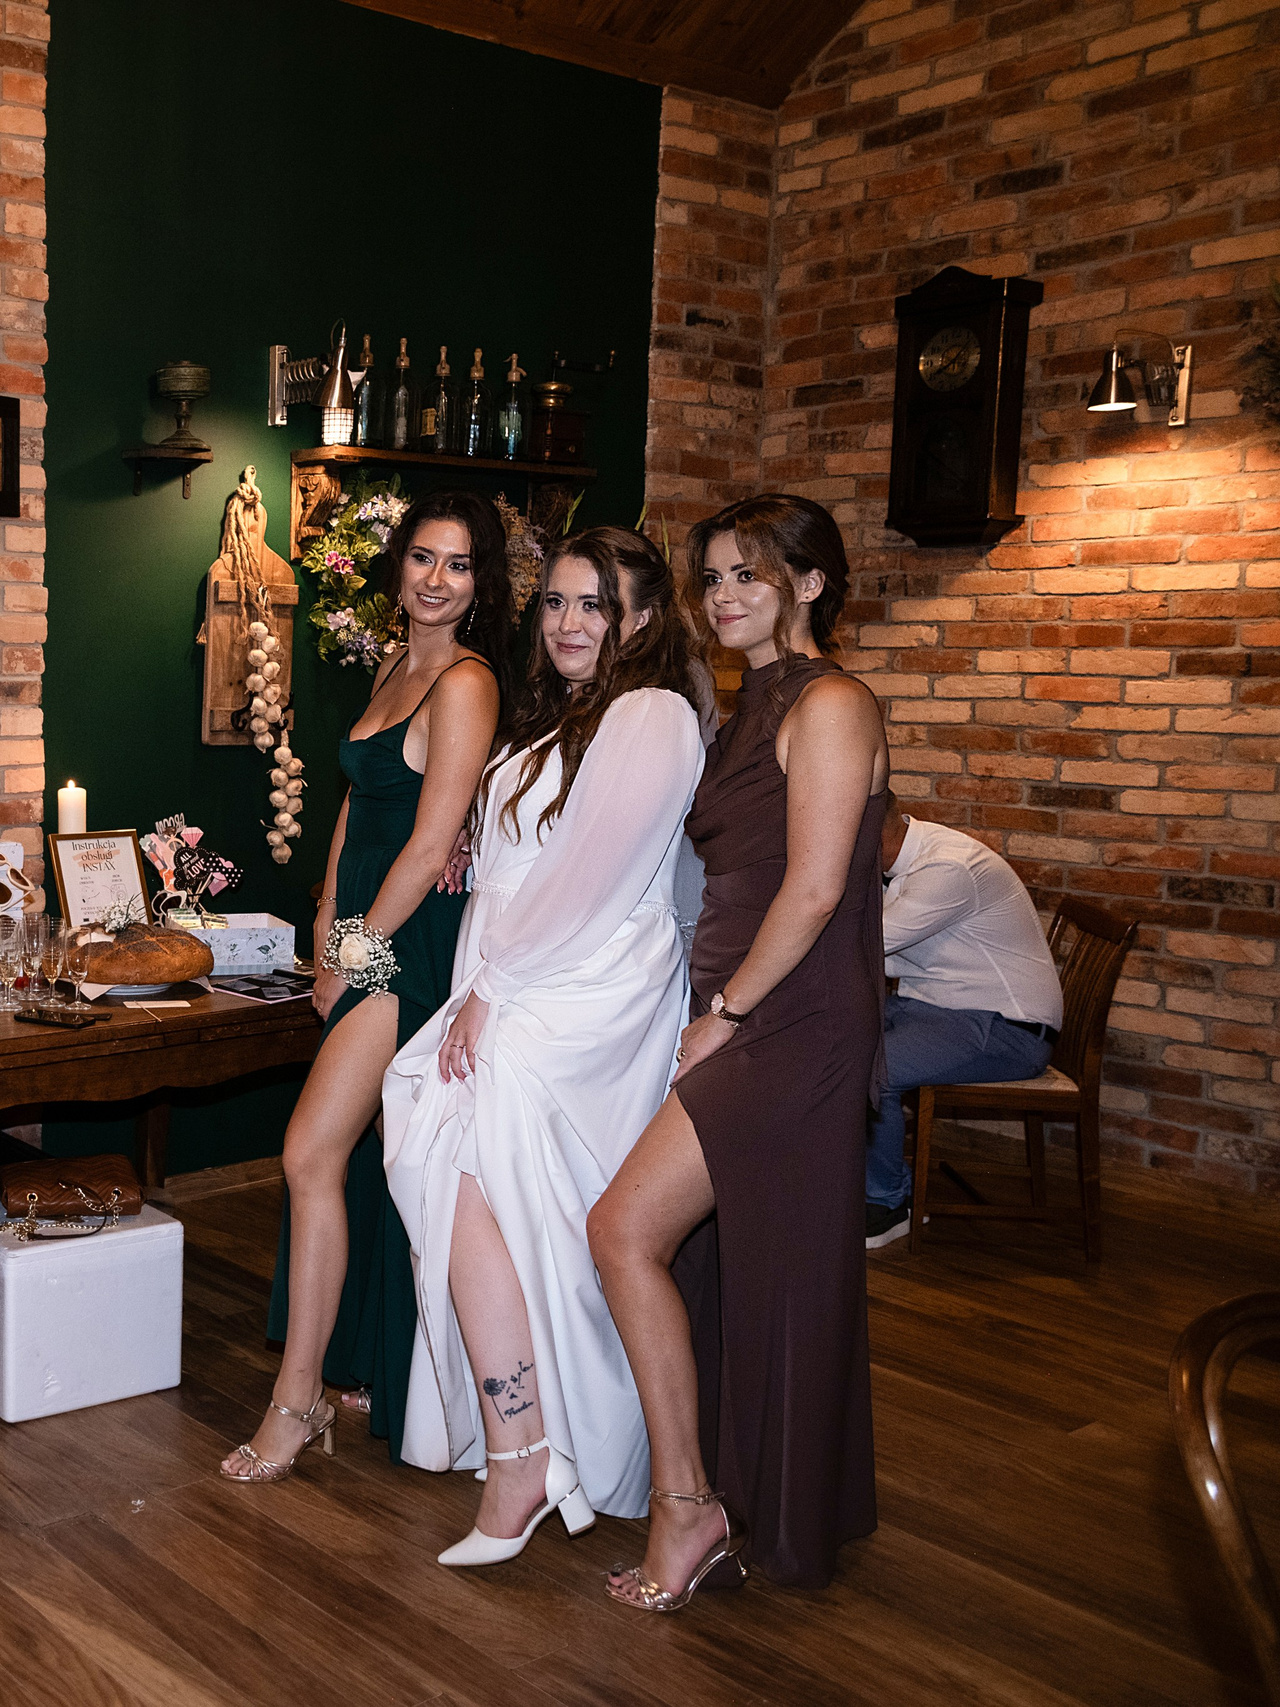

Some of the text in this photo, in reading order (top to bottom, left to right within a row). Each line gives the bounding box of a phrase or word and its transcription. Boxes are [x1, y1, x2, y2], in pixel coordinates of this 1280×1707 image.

[72, 839, 117, 851] Instrukcja
[180, 852, 192, 863] ALL
[82, 860, 116, 873] INSTAX
